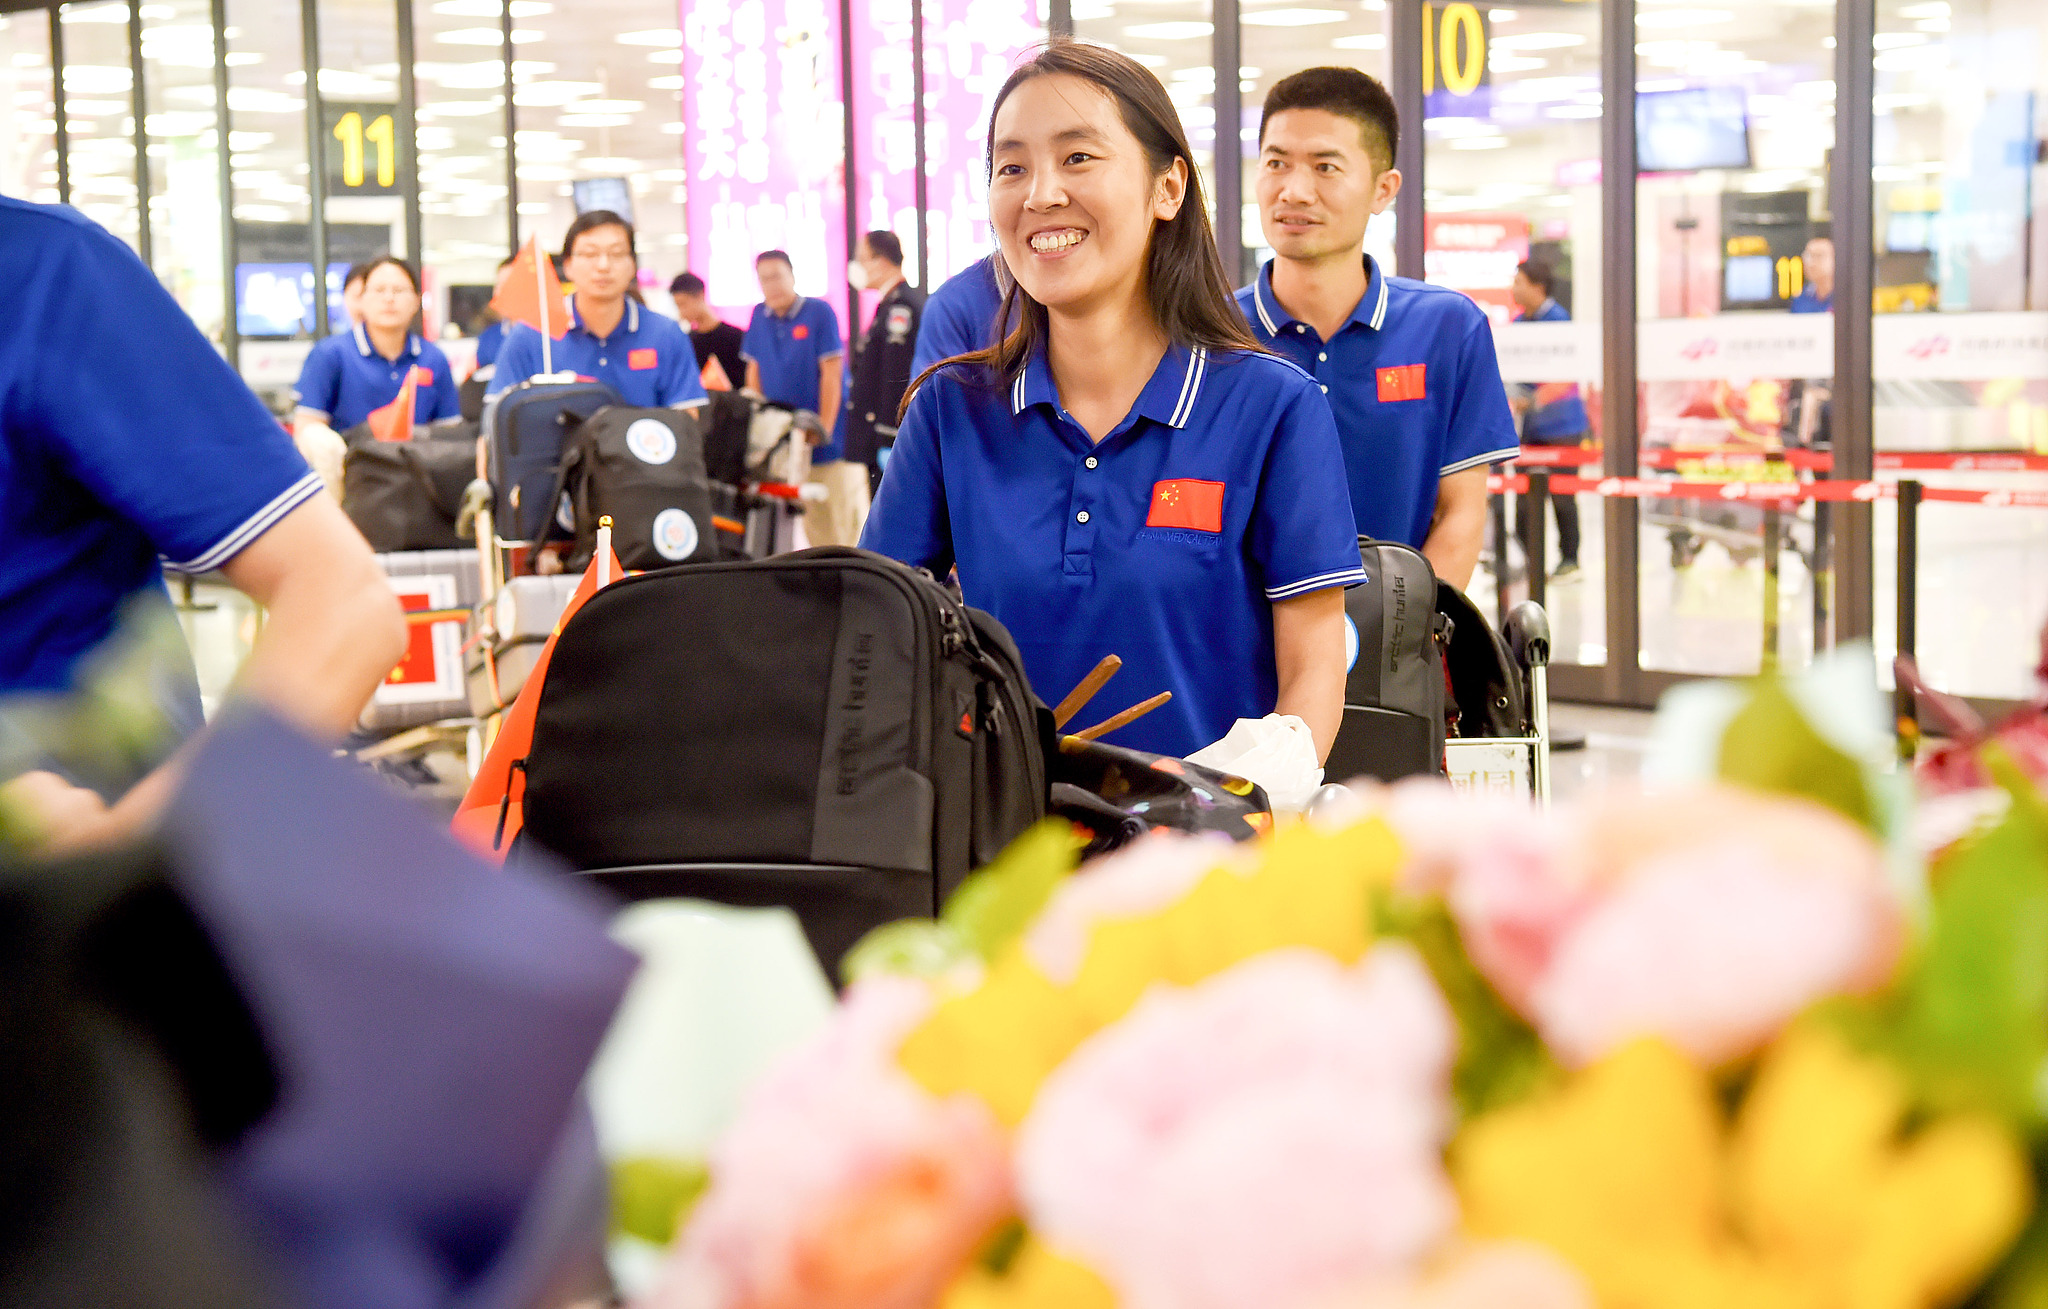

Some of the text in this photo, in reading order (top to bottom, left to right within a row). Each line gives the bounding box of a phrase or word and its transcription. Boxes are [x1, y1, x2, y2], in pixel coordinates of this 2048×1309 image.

[333, 111, 395, 188] 11
[1775, 255, 1804, 300] 11
[1164, 531, 1202, 545] MEDICAL
[1392, 575, 1406, 621] hunter
